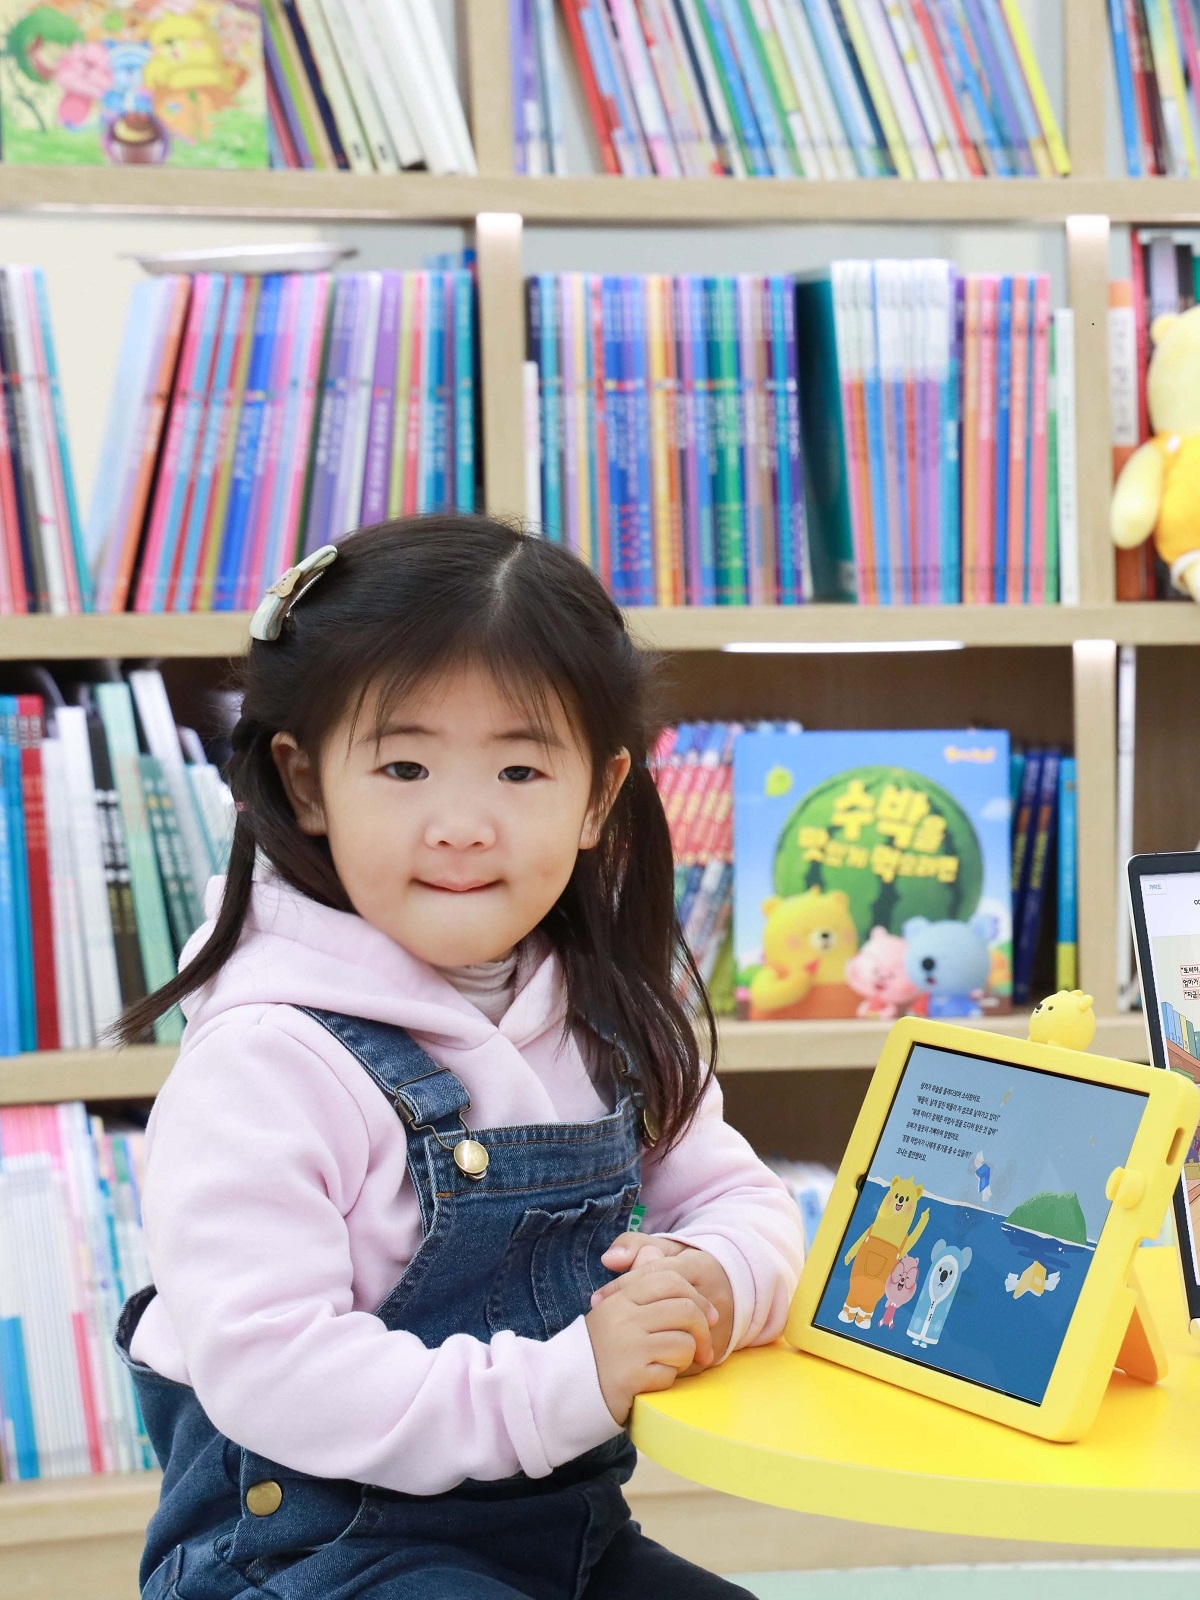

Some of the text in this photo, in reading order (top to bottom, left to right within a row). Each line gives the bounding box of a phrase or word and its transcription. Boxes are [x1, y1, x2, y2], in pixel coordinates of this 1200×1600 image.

[831, 779, 946, 853] 수박을
[1183, 979, 1199, 987] 엄마가
[932, 1085, 943, 1094] 하늘을
[930, 1099, 938, 1107] 날개
[938, 1101, 946, 1109] 달린
[946, 1103, 957, 1111] 책들이
[962, 1107, 973, 1115] 섬으로
[973, 1110, 989, 1119] 날아가고
[921, 1111, 932, 1119] 마녀가
[944, 1117, 955, 1125] 마법사
[963, 1122, 975, 1130] 드디어
[975, 1124, 983, 1132] 찾은
[929, 1128, 944, 1137] 기뻐하며
[911, 1137, 925, 1146] 마법사가
[925, 1141, 936, 1149] 나에게
[936, 1144, 948, 1153] 용기를
